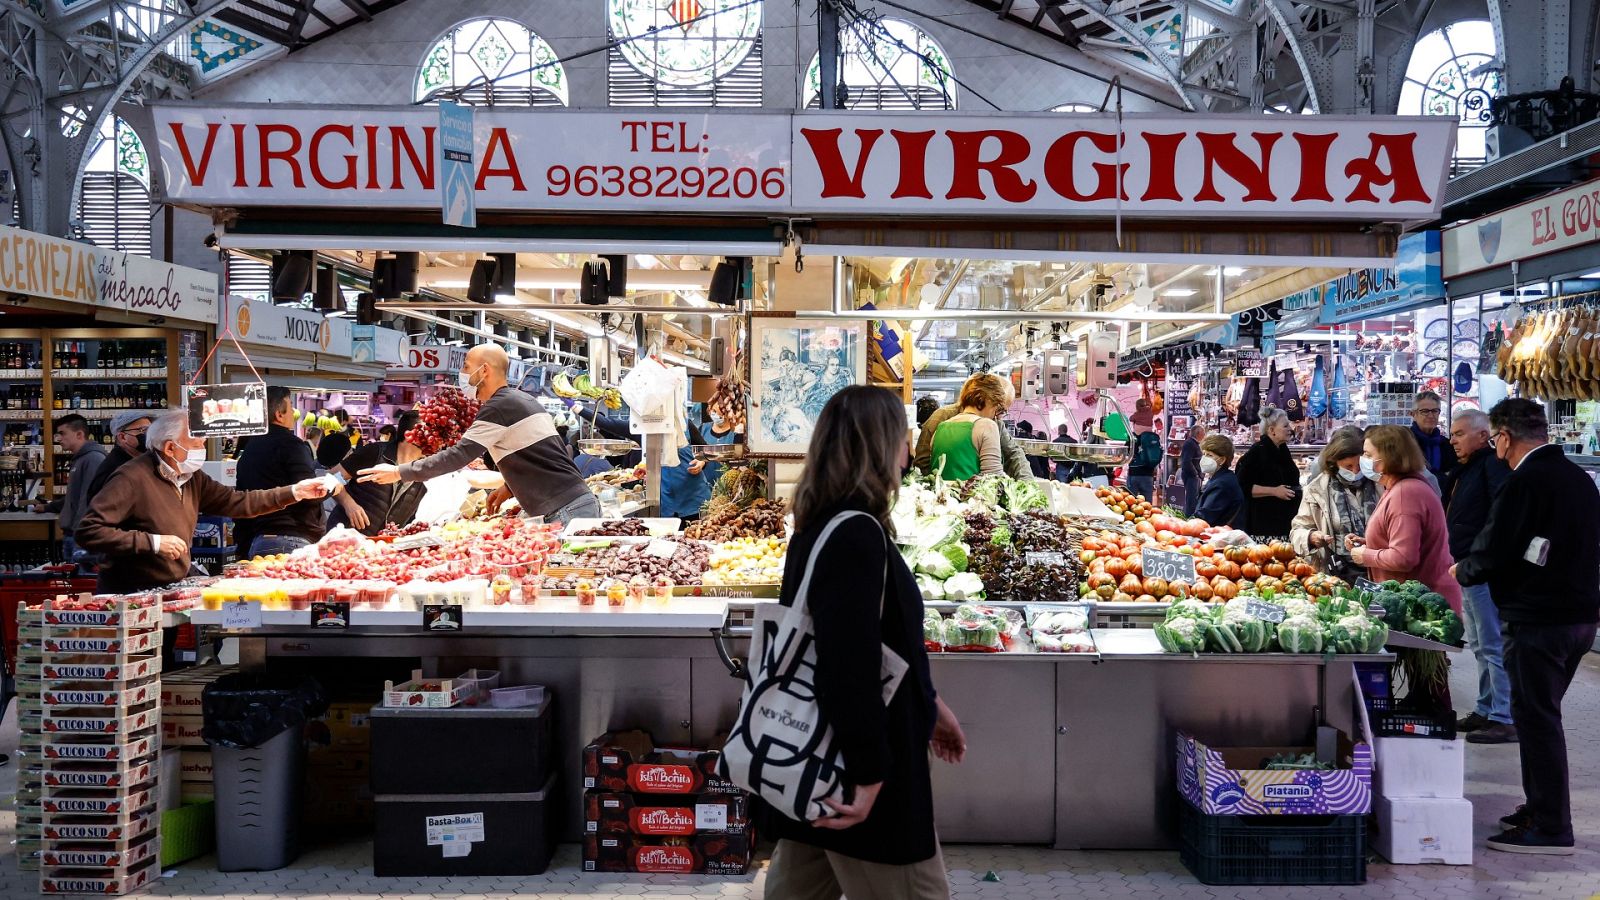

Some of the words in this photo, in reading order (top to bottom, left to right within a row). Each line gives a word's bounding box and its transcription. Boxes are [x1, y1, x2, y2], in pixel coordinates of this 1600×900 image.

[621, 120, 709, 154] TEL:
[168, 122, 528, 192] VIRGINA
[800, 127, 1432, 204] VIRGINIA
[546, 164, 785, 199] 963829206
[1530, 205, 1557, 247] EL
[0, 233, 97, 303] CERVEZAS
[98, 255, 115, 276] del
[100, 267, 182, 312] mercado
[449, 350, 466, 370] FRU
[59, 612, 85, 624] CUCO
[87, 612, 106, 624] SUD
[60, 640, 85, 651] CUCO
[88, 640, 107, 651] SUD
[58, 667, 84, 677] CUCO
[86, 667, 105, 677] SUD
[57, 693, 83, 703] CUCO
[85, 693, 104, 703] SUD
[175, 694, 202, 706] Ruch
[58, 719, 83, 730] CUCO
[85, 719, 105, 730] SUD
[759, 706, 780, 719] NEW
[779, 711, 810, 734] YORKER
[59, 746, 85, 757] CUCO
[87, 746, 106, 757] SUD
[182, 763, 213, 775] uchey
[60, 773, 85, 784] CUCO
[88, 773, 107, 784] SUD
[58, 800, 85, 811] CUCO
[86, 800, 107, 811] SUD
[428, 816, 472, 827] Basta-Box
[59, 827, 85, 837] CUCO
[87, 827, 107, 837] SUD
[59, 853, 85, 864] CUCO
[87, 853, 106, 864] SUD
[57, 881, 83, 891] CUCO
[85, 881, 104, 891] SUD
